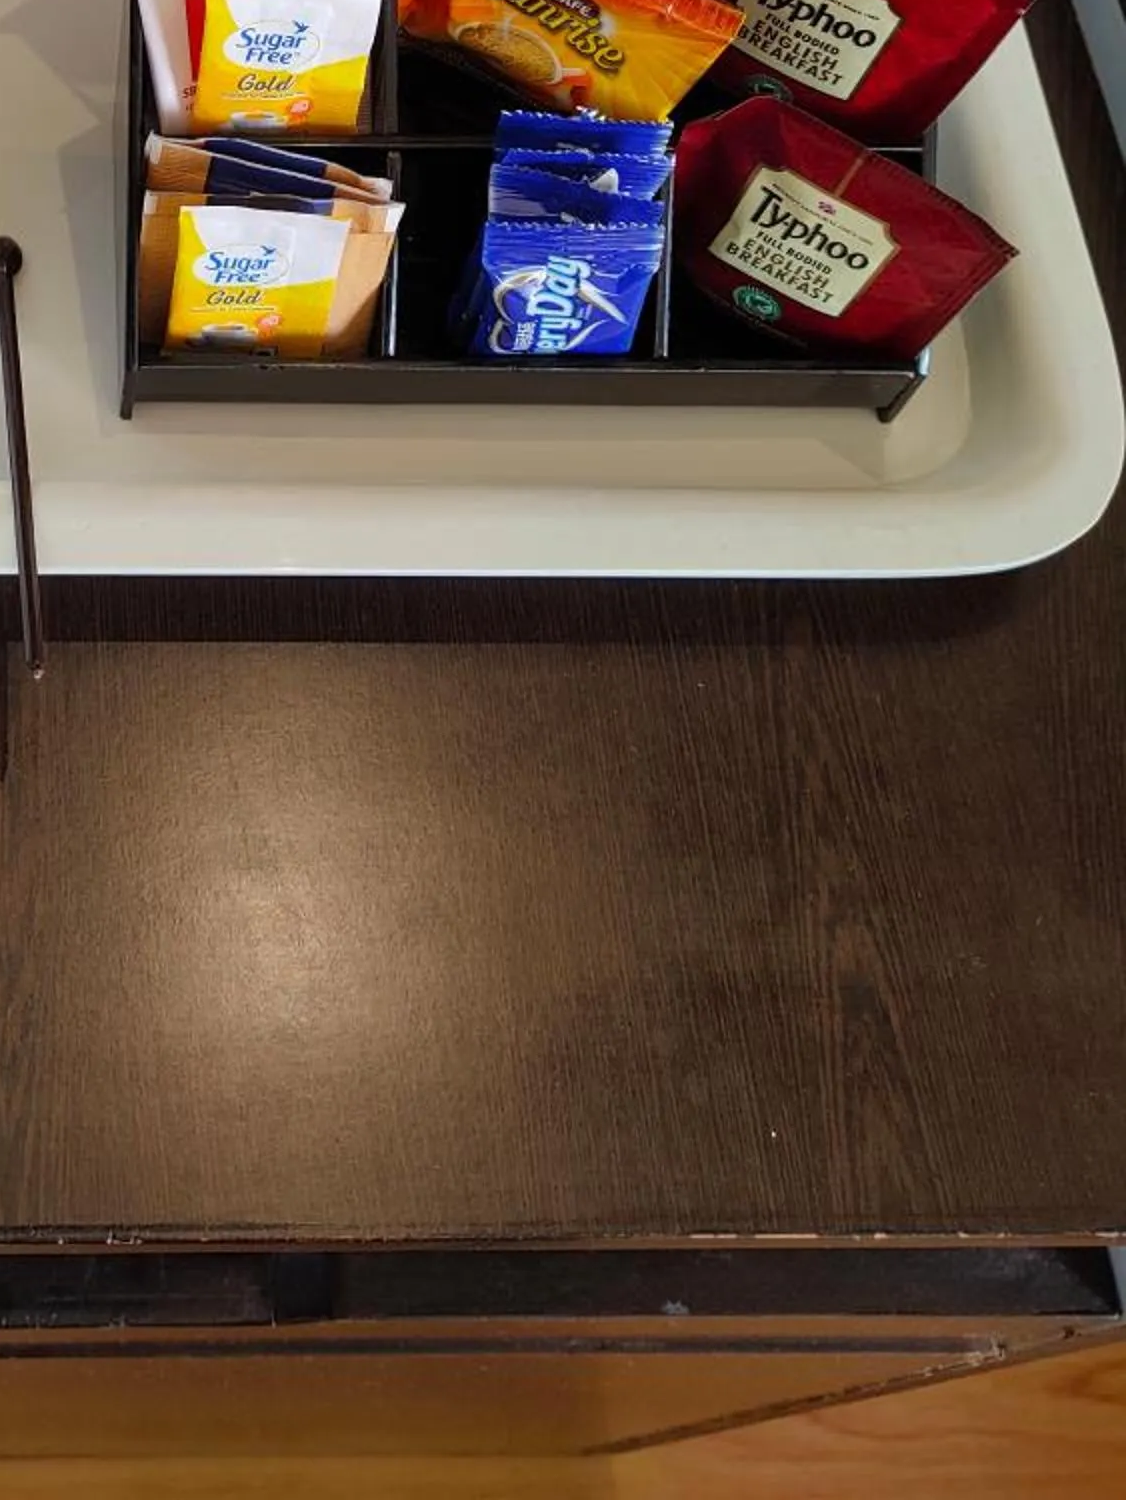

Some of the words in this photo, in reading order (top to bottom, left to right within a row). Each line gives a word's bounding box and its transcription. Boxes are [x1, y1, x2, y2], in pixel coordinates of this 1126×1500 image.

[235, 28, 306, 51] Sugar
[752, 19, 839, 71] ENGLISH
[765, 12, 791, 33] FULL
[793, 29, 840, 56] BODIED
[245, 47, 293, 65] Free
[737, 25, 843, 85] BREAKFAST
[237, 74, 297, 91] Gold
[204, 252, 274, 273] Sugar
[742, 239, 830, 289] ENGLISH
[756, 231, 784, 250] FULL
[787, 247, 832, 275] BODIED
[214, 270, 261, 284] Free
[726, 242, 835, 303] BREAKFAST
[206, 290, 263, 306] Gold
